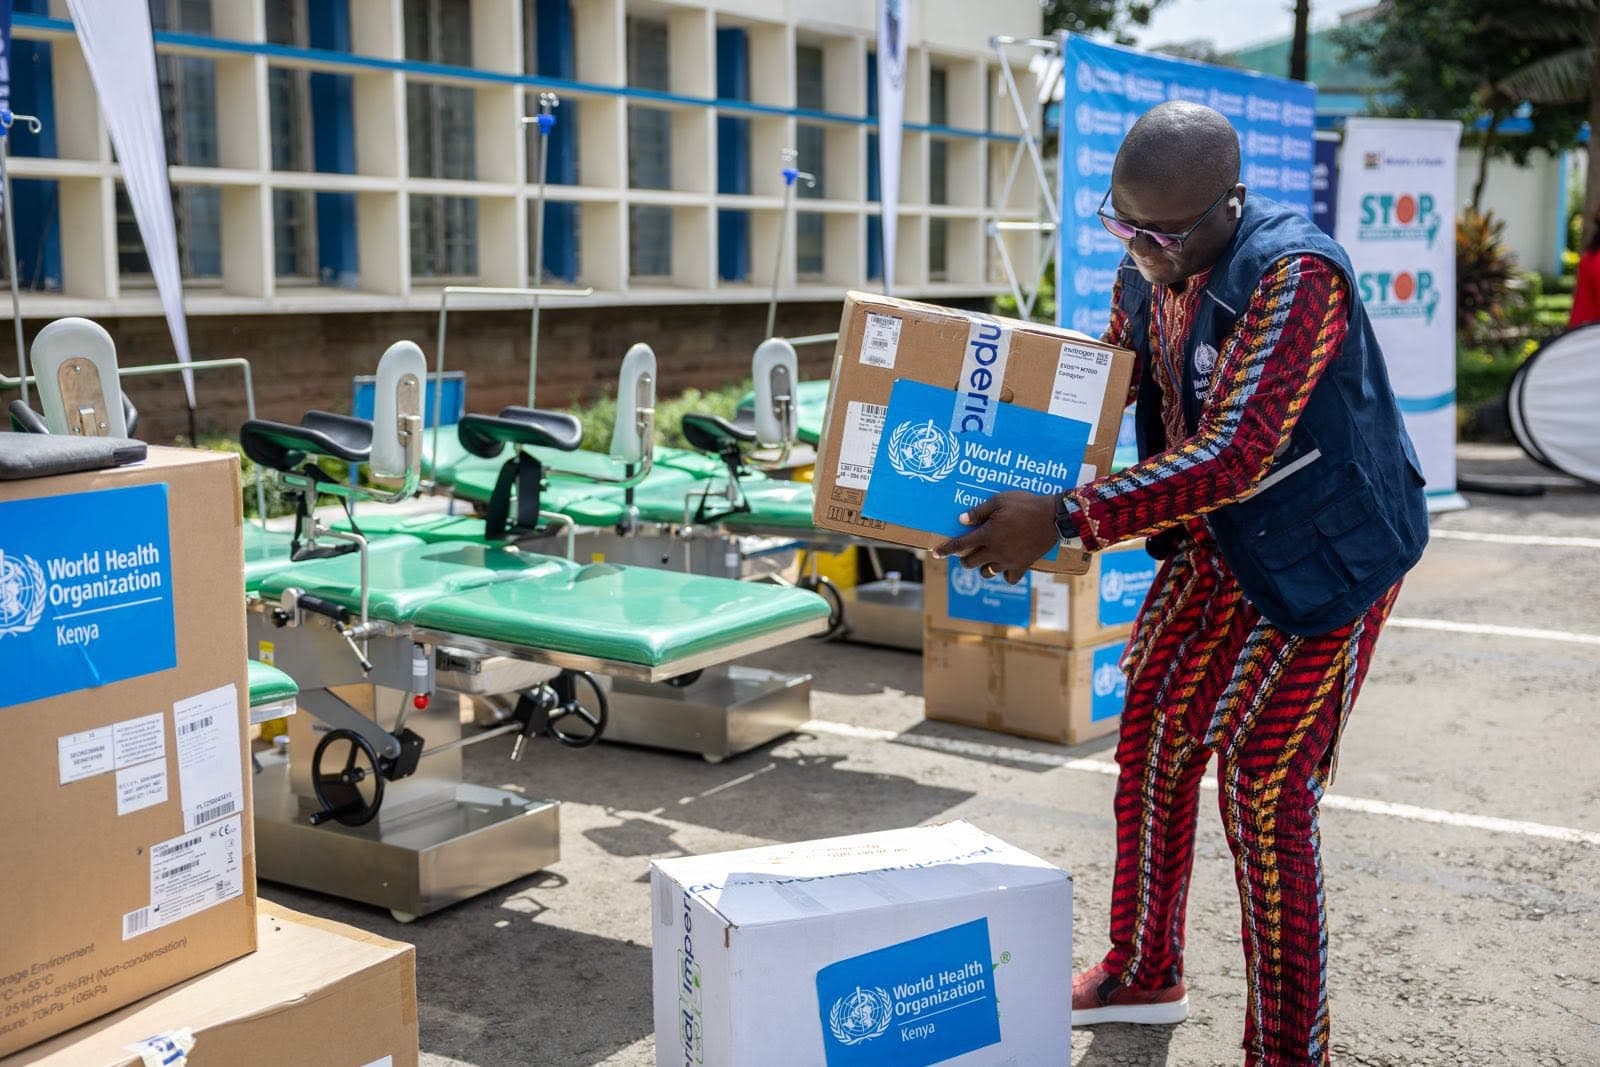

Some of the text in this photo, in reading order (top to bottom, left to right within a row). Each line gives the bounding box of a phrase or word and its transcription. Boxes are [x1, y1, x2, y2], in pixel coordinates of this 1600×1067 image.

[1360, 193, 1434, 225] STOP
[1359, 270, 1433, 303] STOP
[959, 459, 1063, 495] Organization
[964, 441, 1068, 480] World Health
[47, 543, 160, 580] World Health
[50, 569, 161, 608] Organization
[56, 623, 99, 646] Kenya
[31, 943, 95, 975] Environment
[96, 935, 188, 981] (Non-condensation)
[893, 960, 984, 1000] World Health
[895, 979, 985, 1016] Organization
[901, 1023, 935, 1042] Kenya
